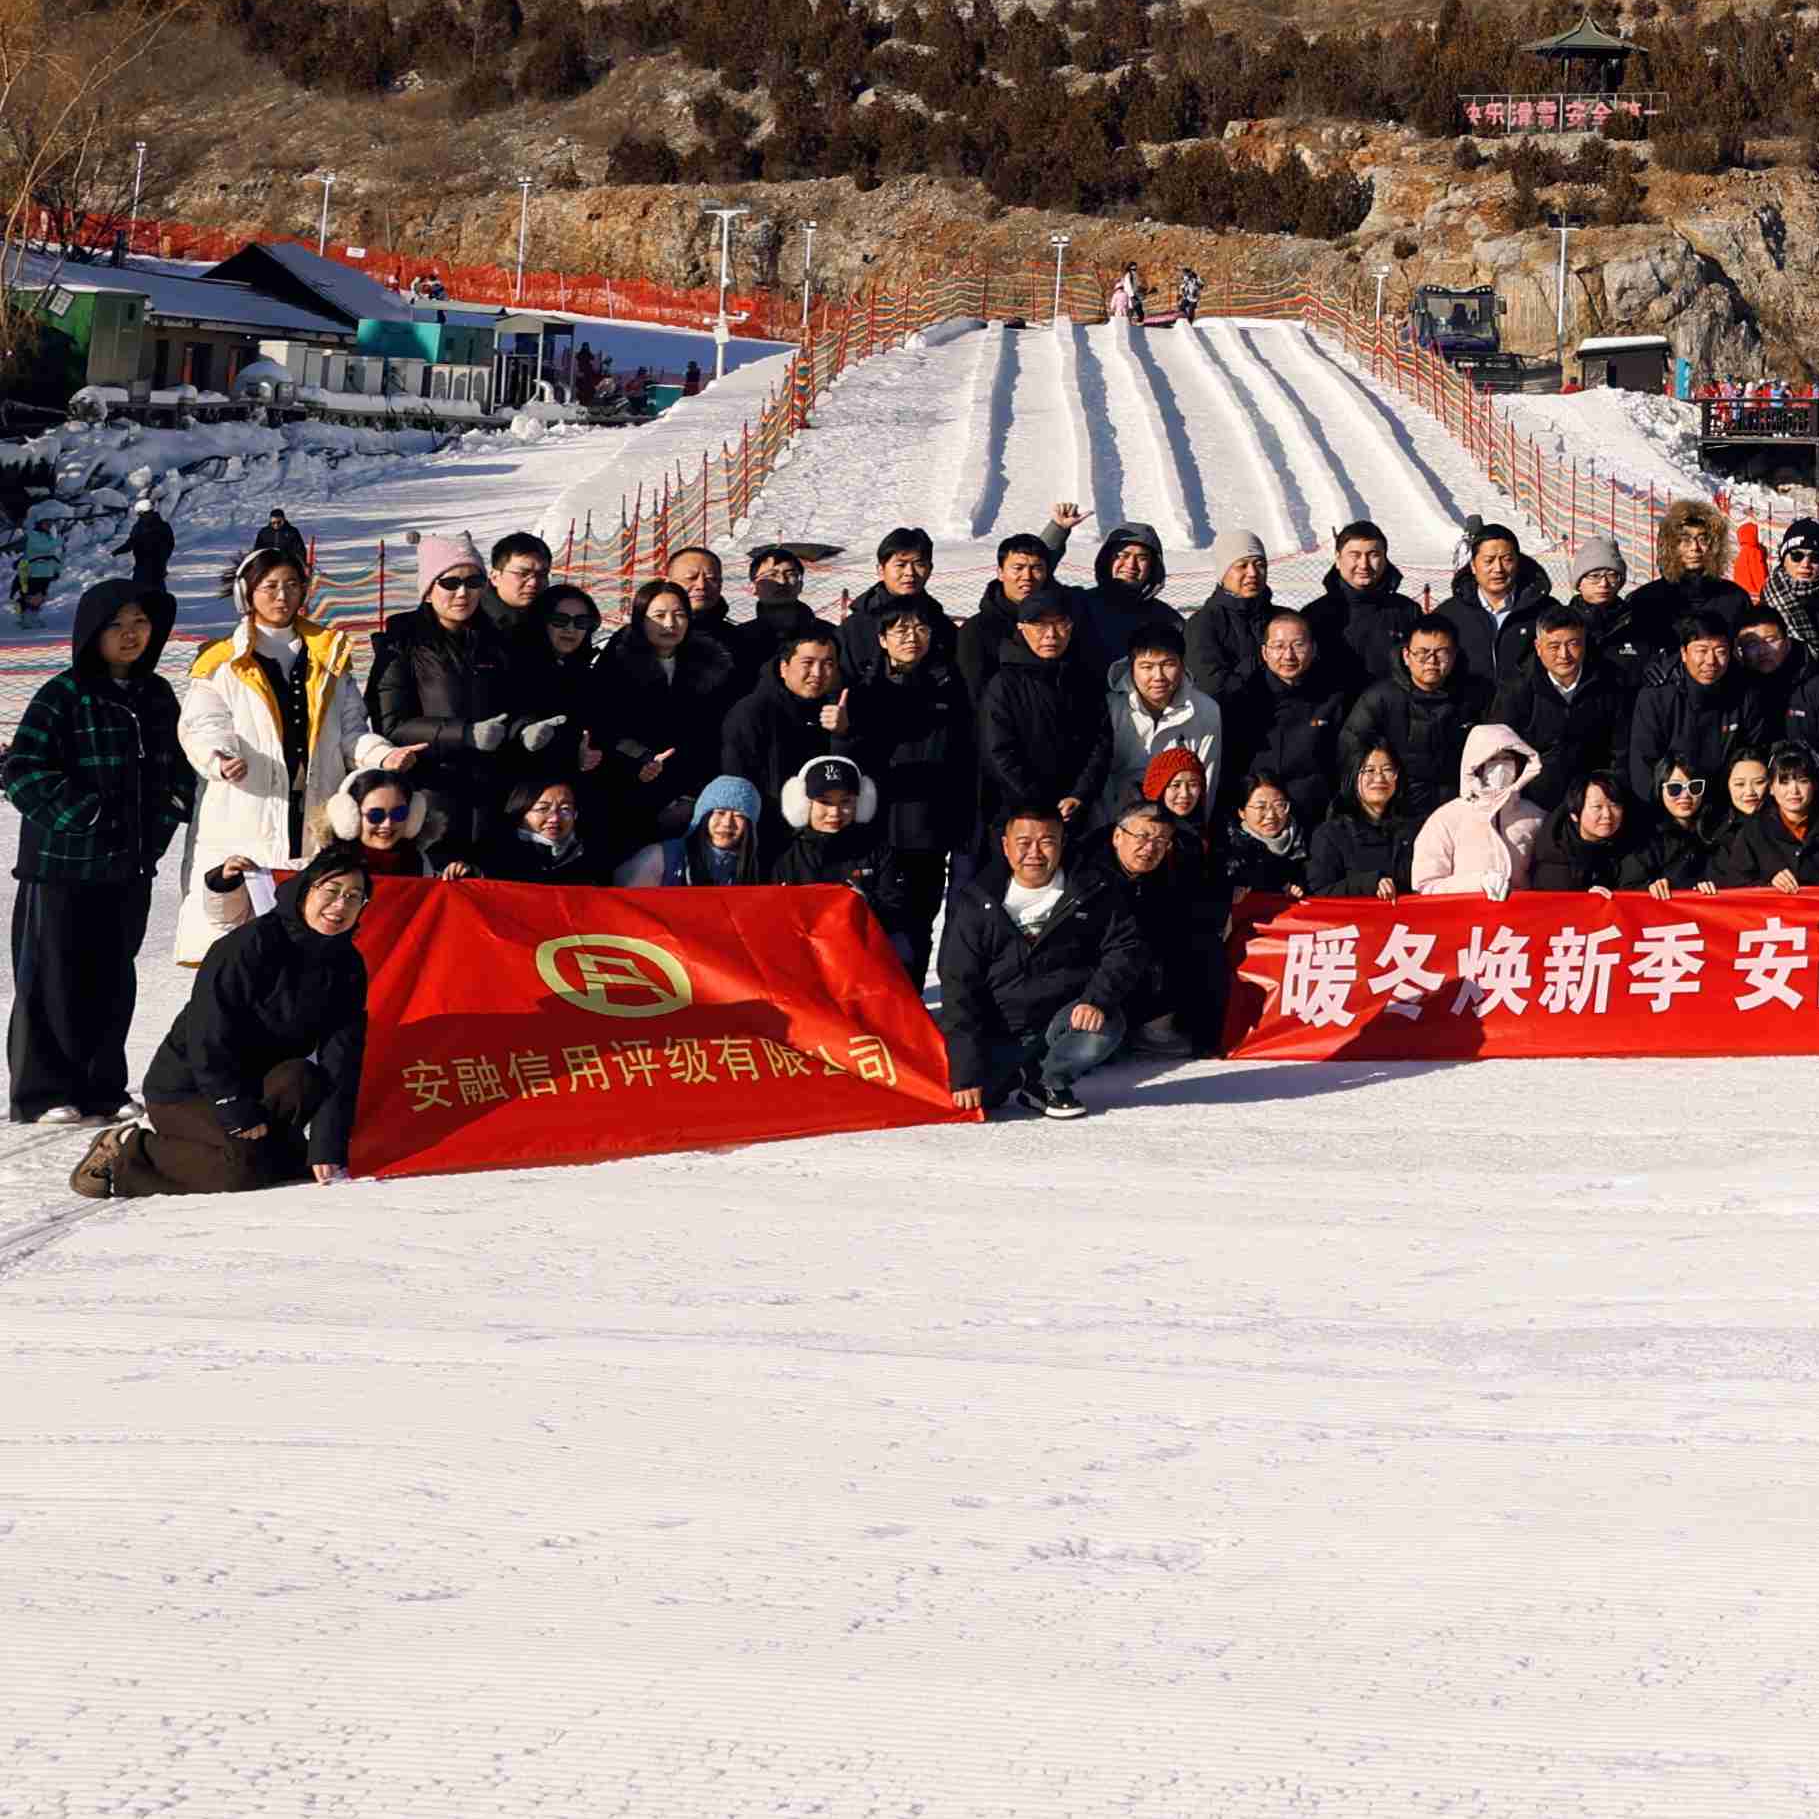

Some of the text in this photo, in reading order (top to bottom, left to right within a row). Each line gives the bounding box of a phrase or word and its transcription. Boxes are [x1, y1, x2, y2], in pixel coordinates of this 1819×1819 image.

[1280, 922, 1704, 1029] 暖冬焕新季
[402, 1035, 897, 1113] 安融信用评级有限公司
